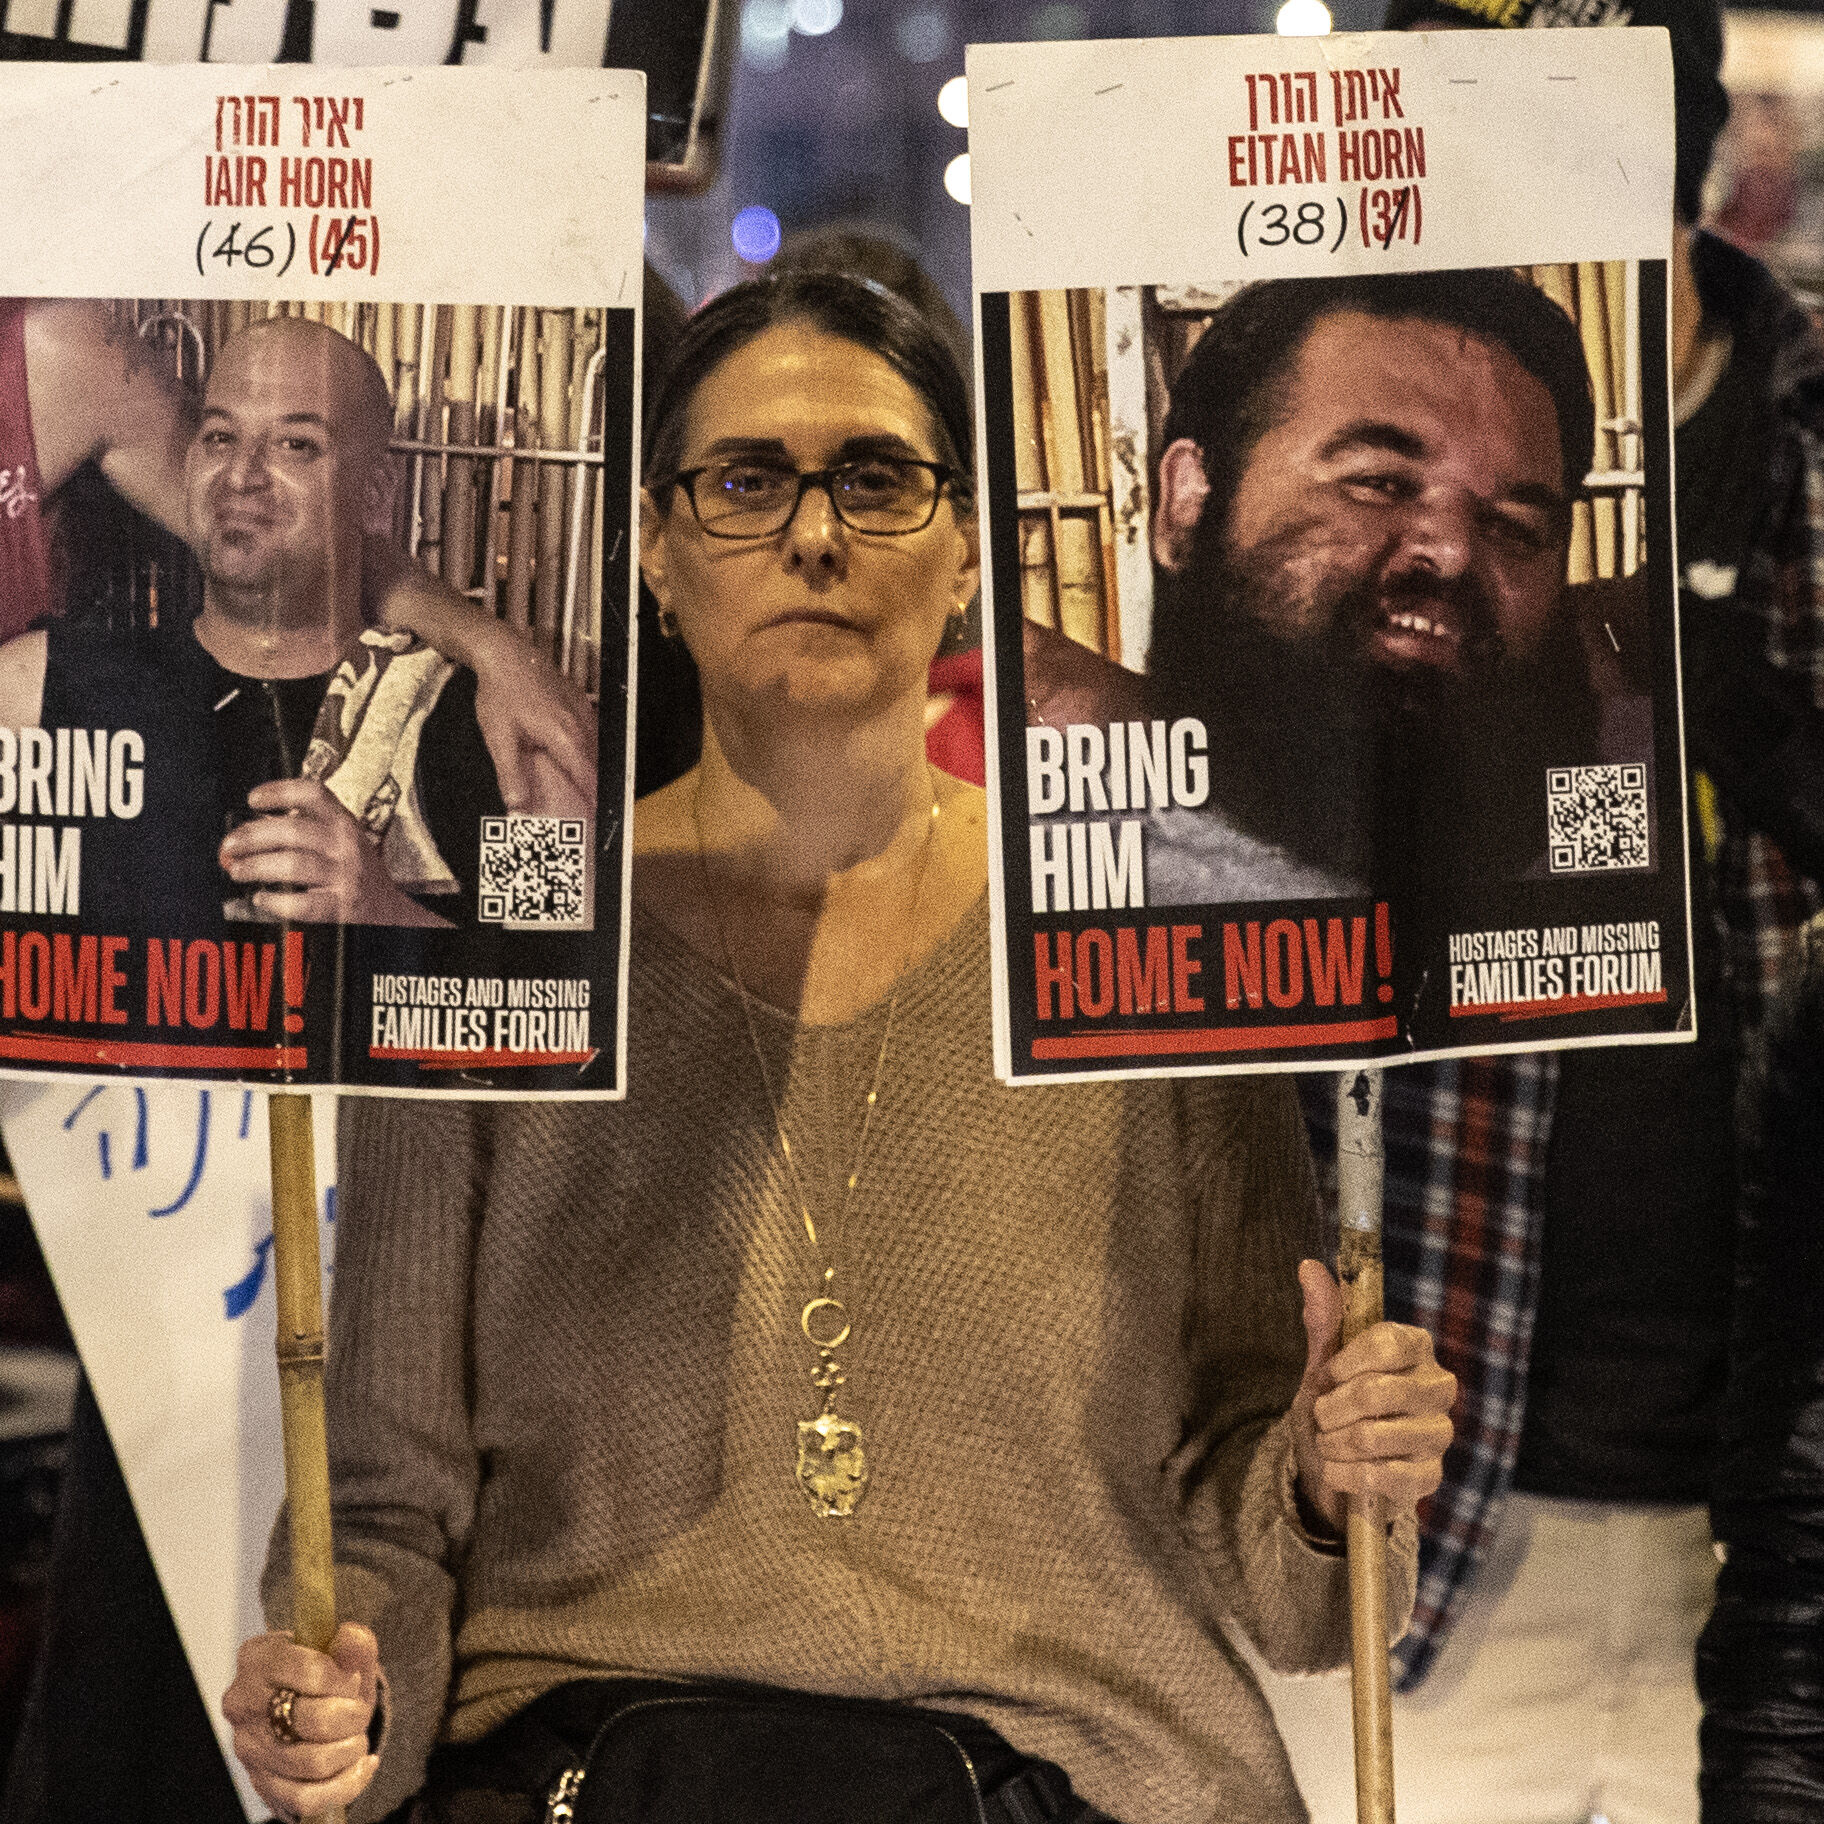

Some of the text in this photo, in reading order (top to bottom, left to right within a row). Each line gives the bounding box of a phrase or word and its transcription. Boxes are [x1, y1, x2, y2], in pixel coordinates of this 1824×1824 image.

[215, 96, 364, 152] יאיר הורן
[1244, 68, 1404, 131] איתן הורן
[205, 155, 373, 209] IAIR HORN
[1228, 127, 1427, 188] EITAN HORN
[195, 220, 296, 276] (46)
[1236, 197, 1348, 256] (38)
[1026, 718, 1210, 815] BRING
[1029, 821, 1145, 913] HIM
[1034, 902, 1395, 1021] HOME NOW!
[1449, 921, 1660, 963] HOSTAGES AND MISSING
[146, 930, 308, 1034] NOW!
[372, 974, 590, 1009] HOSTAGES AND MISSING
[1450, 954, 1663, 1008] FAMILIES FORUM
[372, 1005, 590, 1054] FAMILIES FORUM
